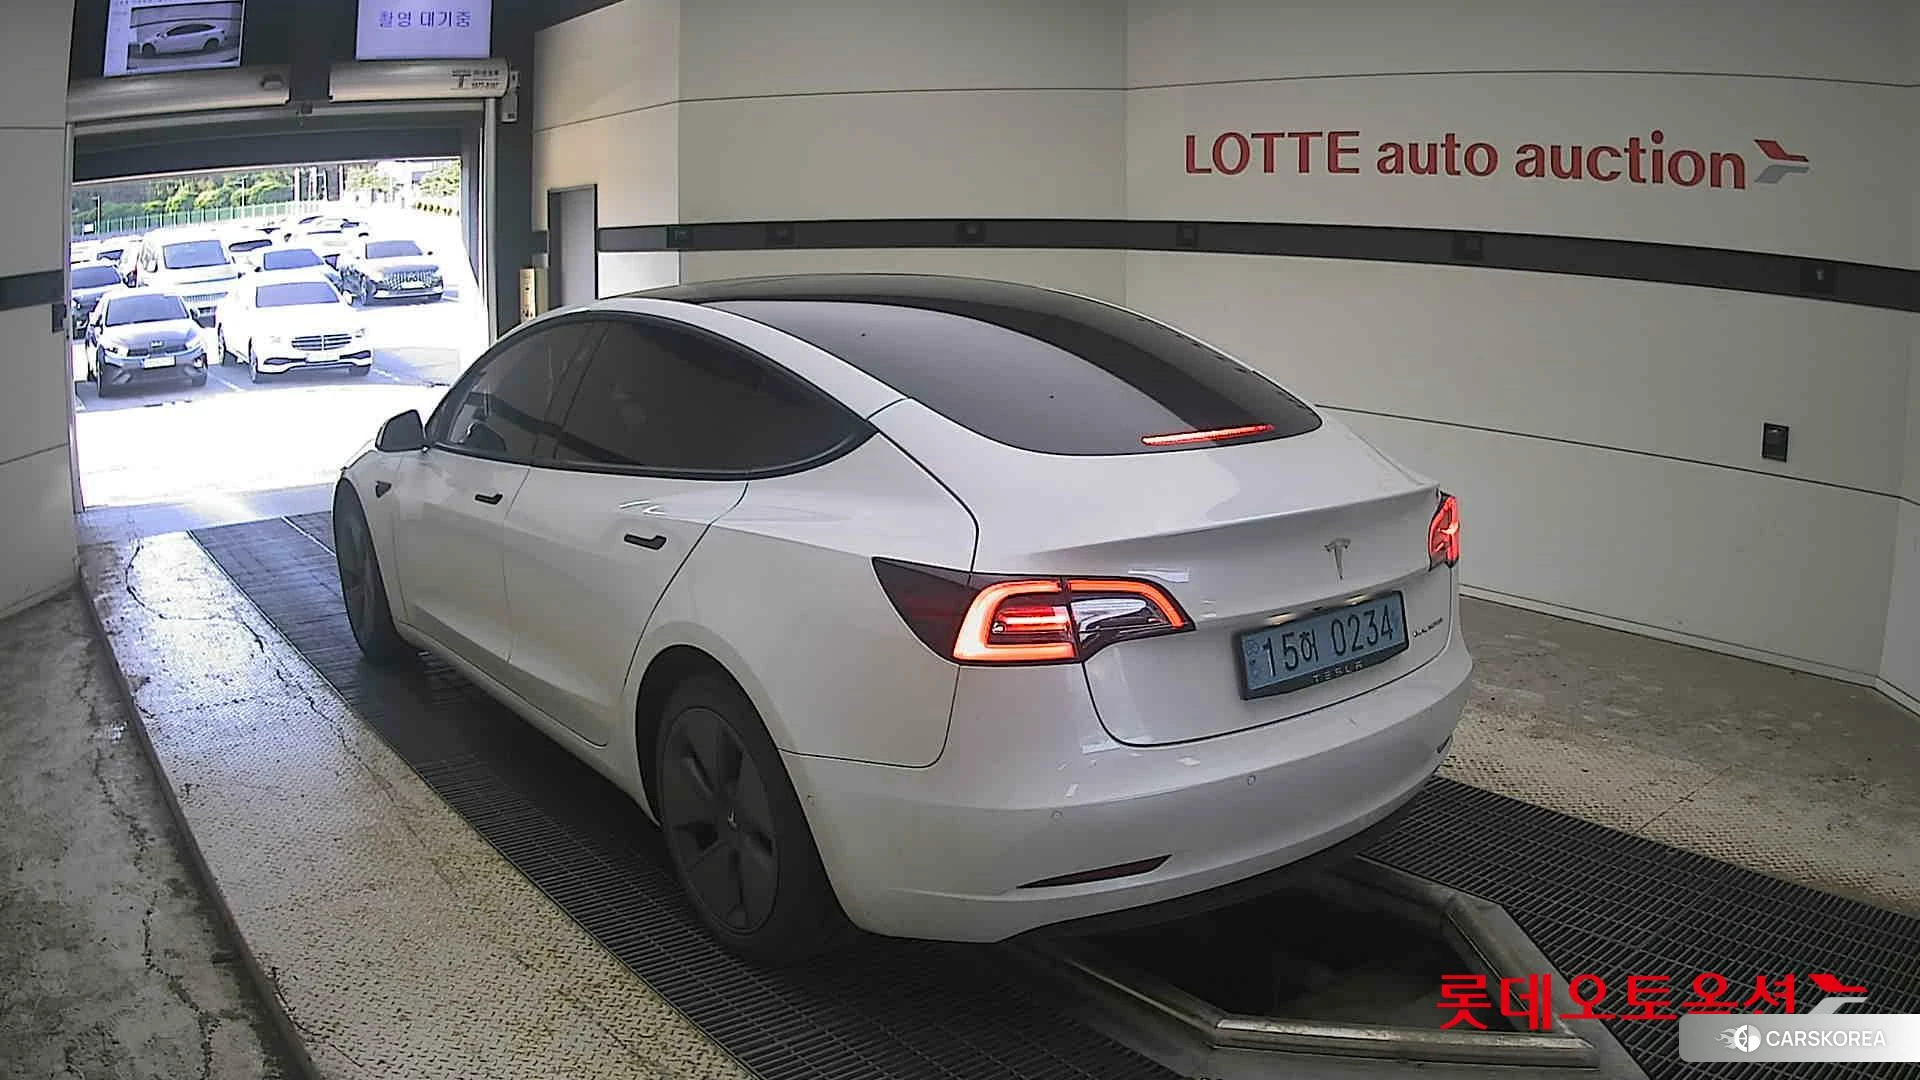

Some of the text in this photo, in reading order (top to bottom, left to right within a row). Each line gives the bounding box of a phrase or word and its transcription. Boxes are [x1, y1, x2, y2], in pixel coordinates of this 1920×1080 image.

[420, 10, 471, 28] 대기중
[1186, 130, 1746, 189] LOTTE auto auction
[1331, 604, 1393, 656] 0234
